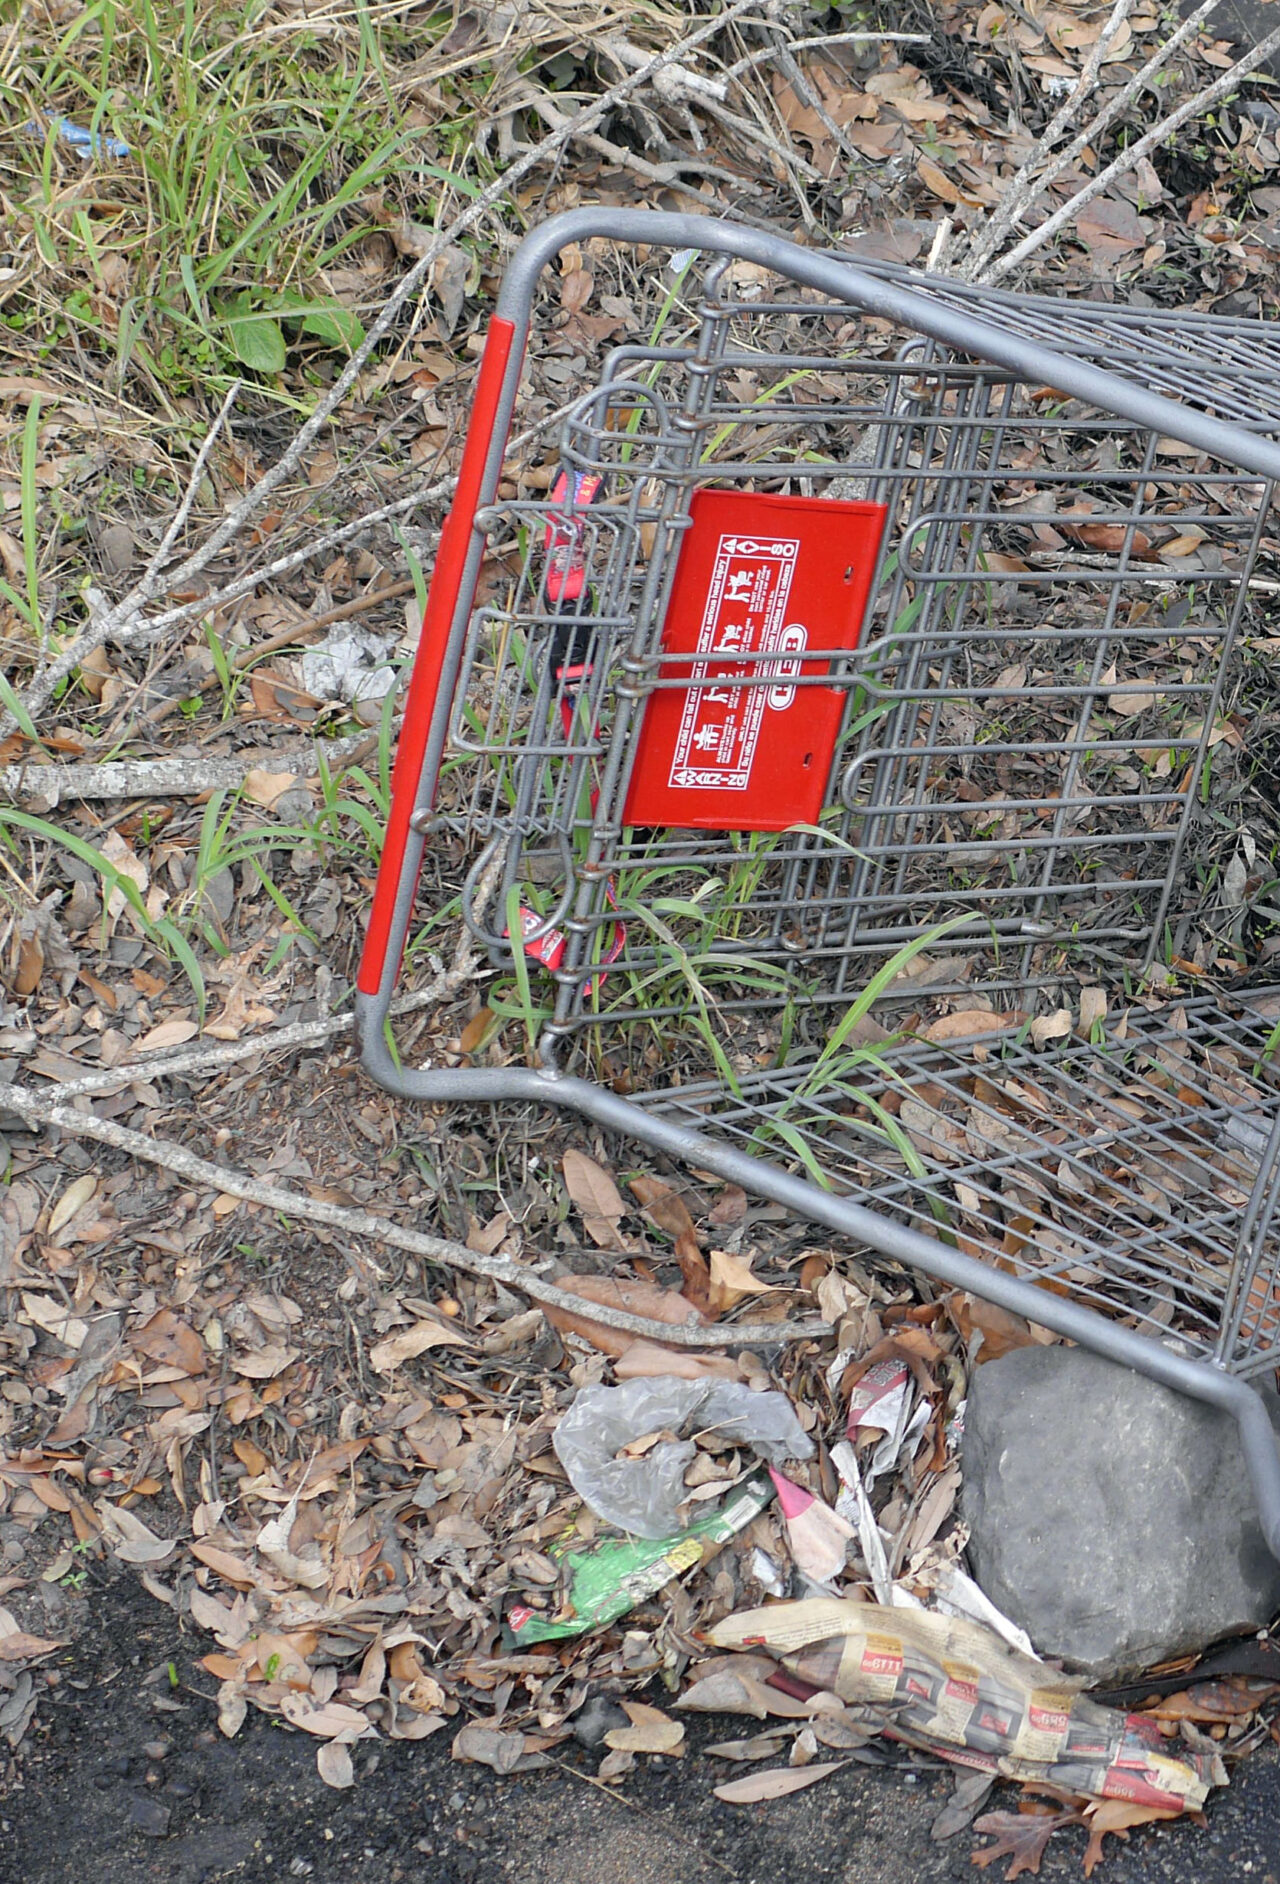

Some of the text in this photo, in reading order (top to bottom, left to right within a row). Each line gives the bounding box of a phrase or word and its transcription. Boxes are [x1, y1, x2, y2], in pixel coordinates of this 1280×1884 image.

[733, 539, 796, 557] AVISO
[714, 558, 726, 579] injury
[778, 563, 791, 590] cabeza
[710, 579, 721, 598] head
[776, 589, 786, 597] la
[774, 597, 784, 608] en
[704, 598, 717, 625] serious
[768, 607, 782, 634] heridas
[698, 631, 710, 652] suffer
[693, 667, 702, 678] art
[688, 690, 698, 702] out
[752, 692, 764, 708] caer
[685, 703, 695, 714] fall
[682, 714, 692, 728] can
[748, 708, 762, 731] puede
[679, 729, 689, 746] child
[746, 730, 755, 740] se
[675, 746, 686, 764] Your
[742, 739, 753, 756] niño
[740, 756, 750, 767] Su
[684, 769, 747, 788] WARNING
